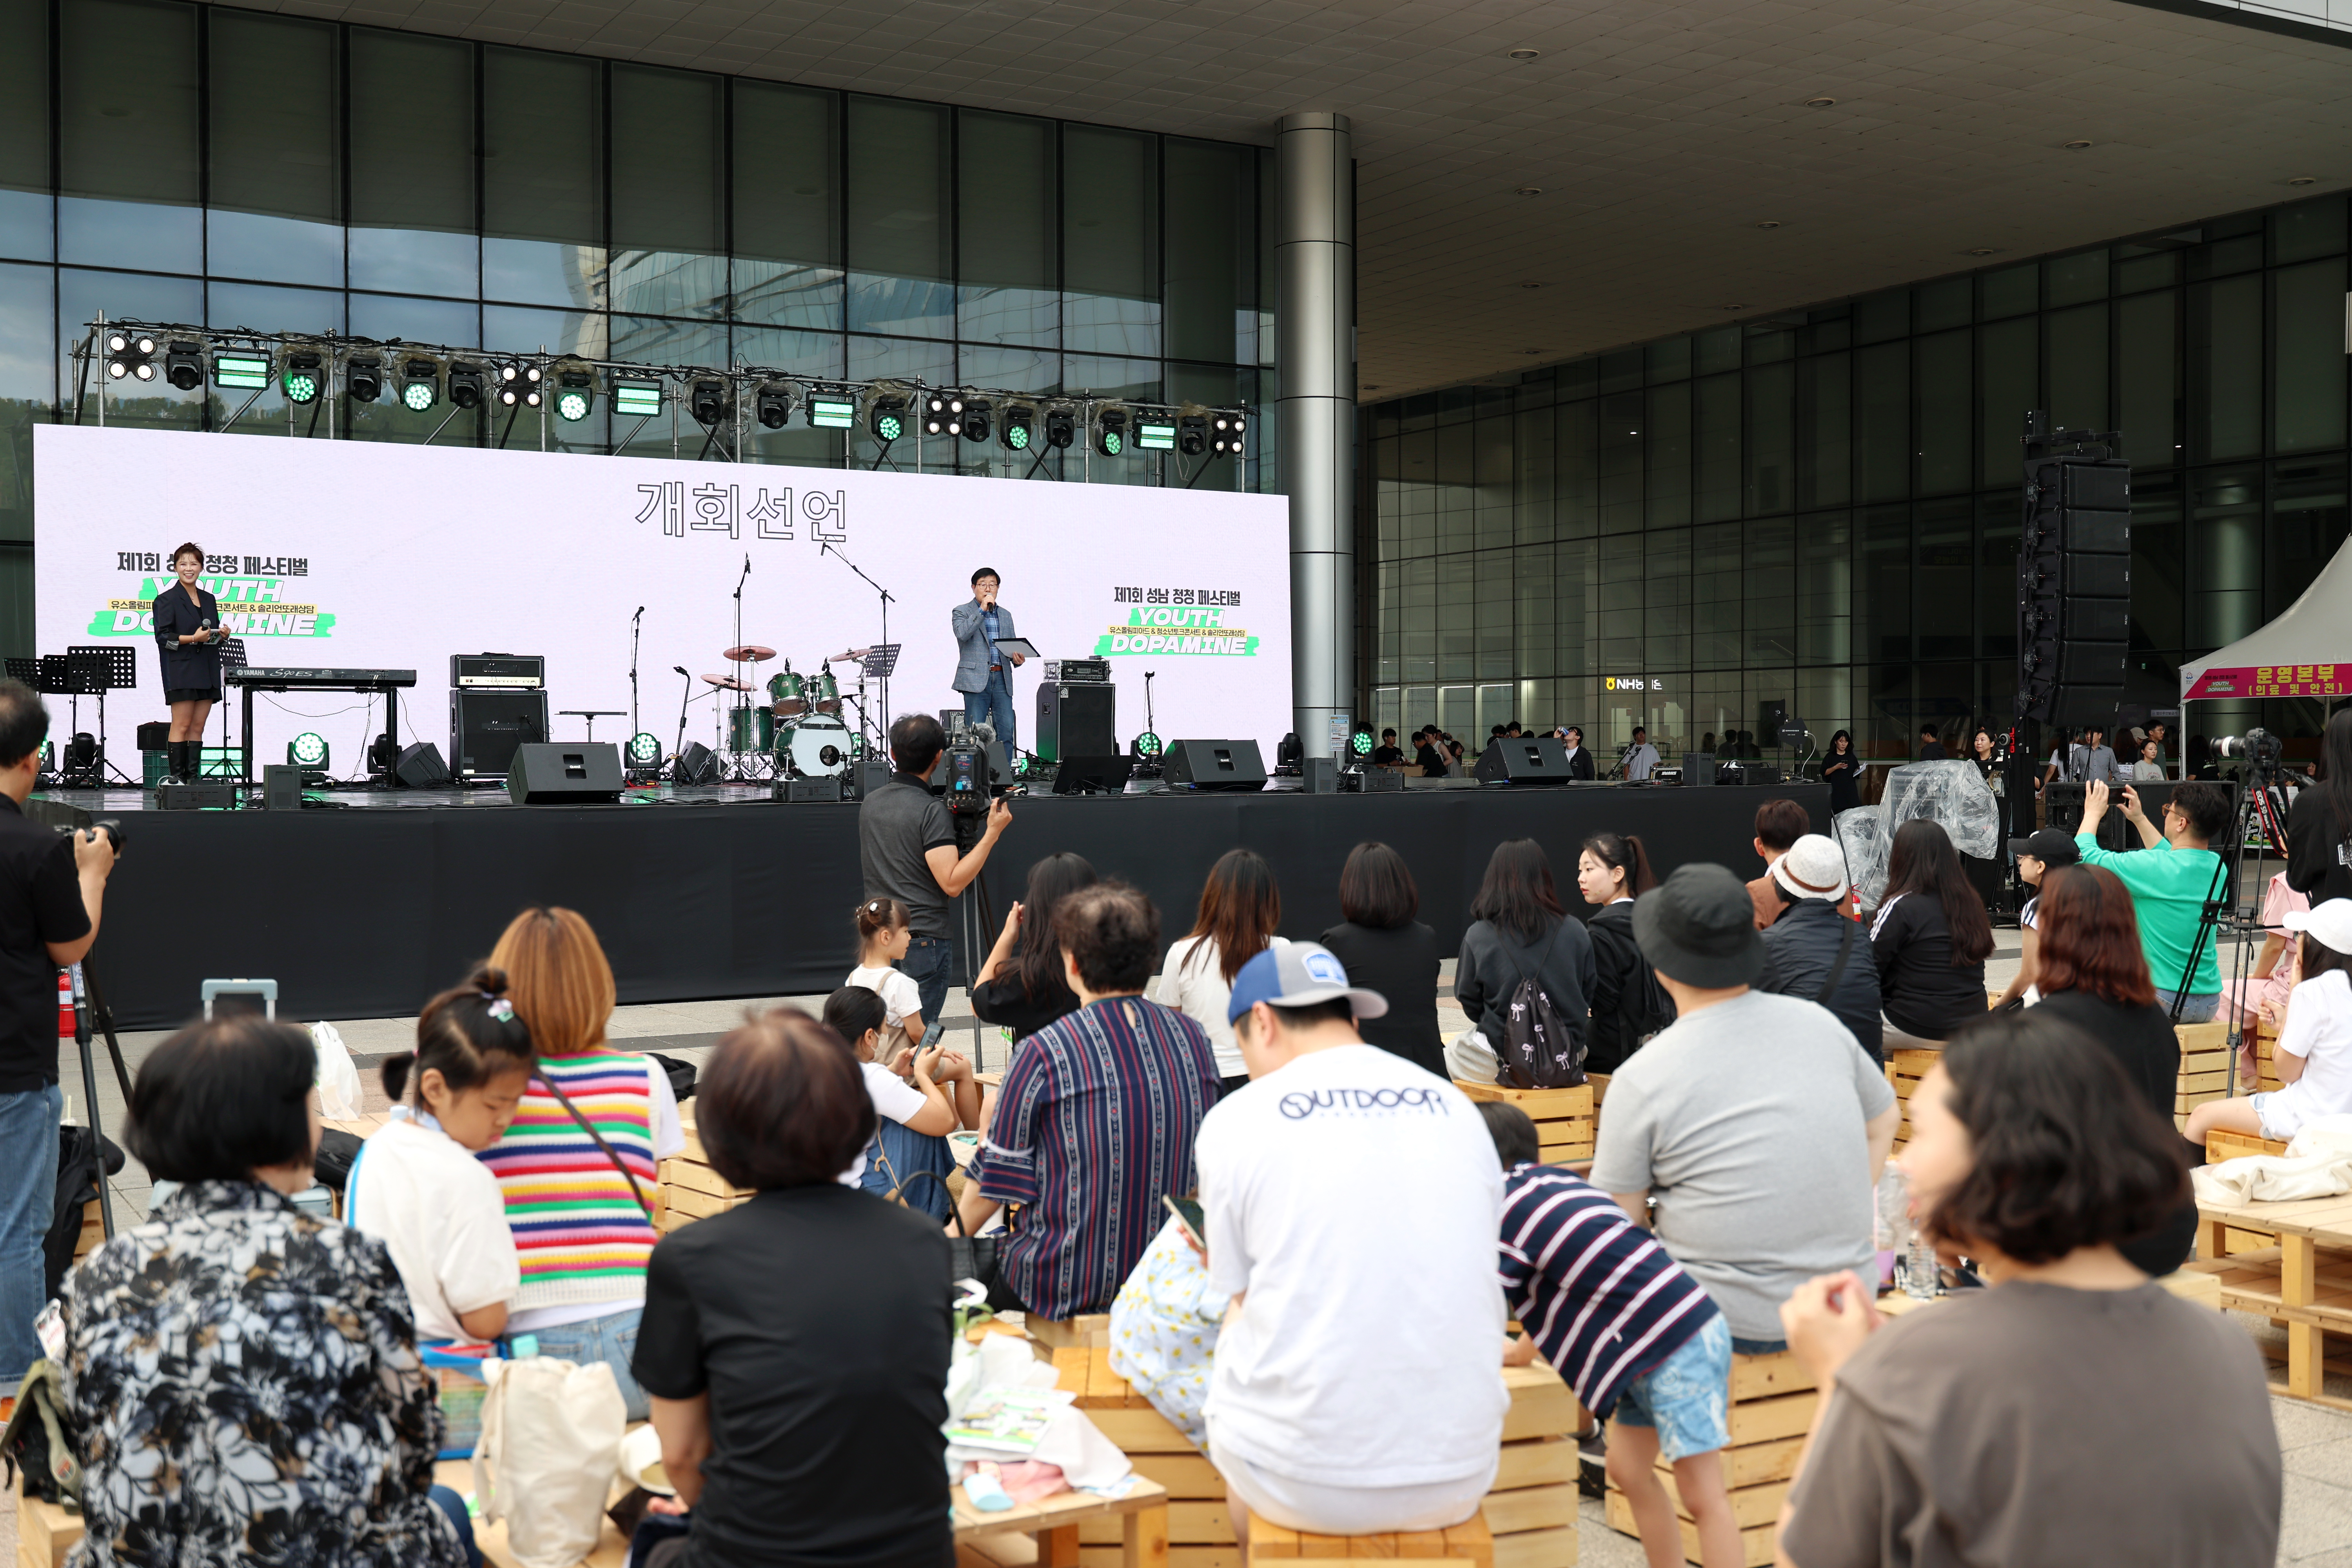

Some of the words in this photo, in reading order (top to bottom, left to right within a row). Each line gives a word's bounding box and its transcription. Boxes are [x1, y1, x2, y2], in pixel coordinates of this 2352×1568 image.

[635, 481, 846, 542] 개회선언
[117, 552, 160, 572] 제1회
[243, 556, 308, 576] 페스티벌
[151, 577, 285, 602] YUTH
[1114, 587, 1143, 603] 제1회
[1147, 588, 1169, 604] 성남
[1173, 588, 1194, 605] 청청
[1198, 590, 1241, 606] 페스티벌
[111, 601, 153, 610] 유스올림피
[258, 604, 315, 614] 솔리언또래상담
[1137, 607, 1225, 628] YOUTH
[111, 610, 319, 635] DOMINE
[1109, 626, 1150, 635] 유스올림피아드
[1156, 628, 1201, 636] 청소년토크콘서트
[1110, 634, 1248, 655] DOPAMINE
[2256, 665, 2334, 684] 운영본부
[2290, 684, 2299, 695] 및
[2256, 791, 2265, 806] EOS
[1279, 1087, 1449, 1120] OUTDOOR
